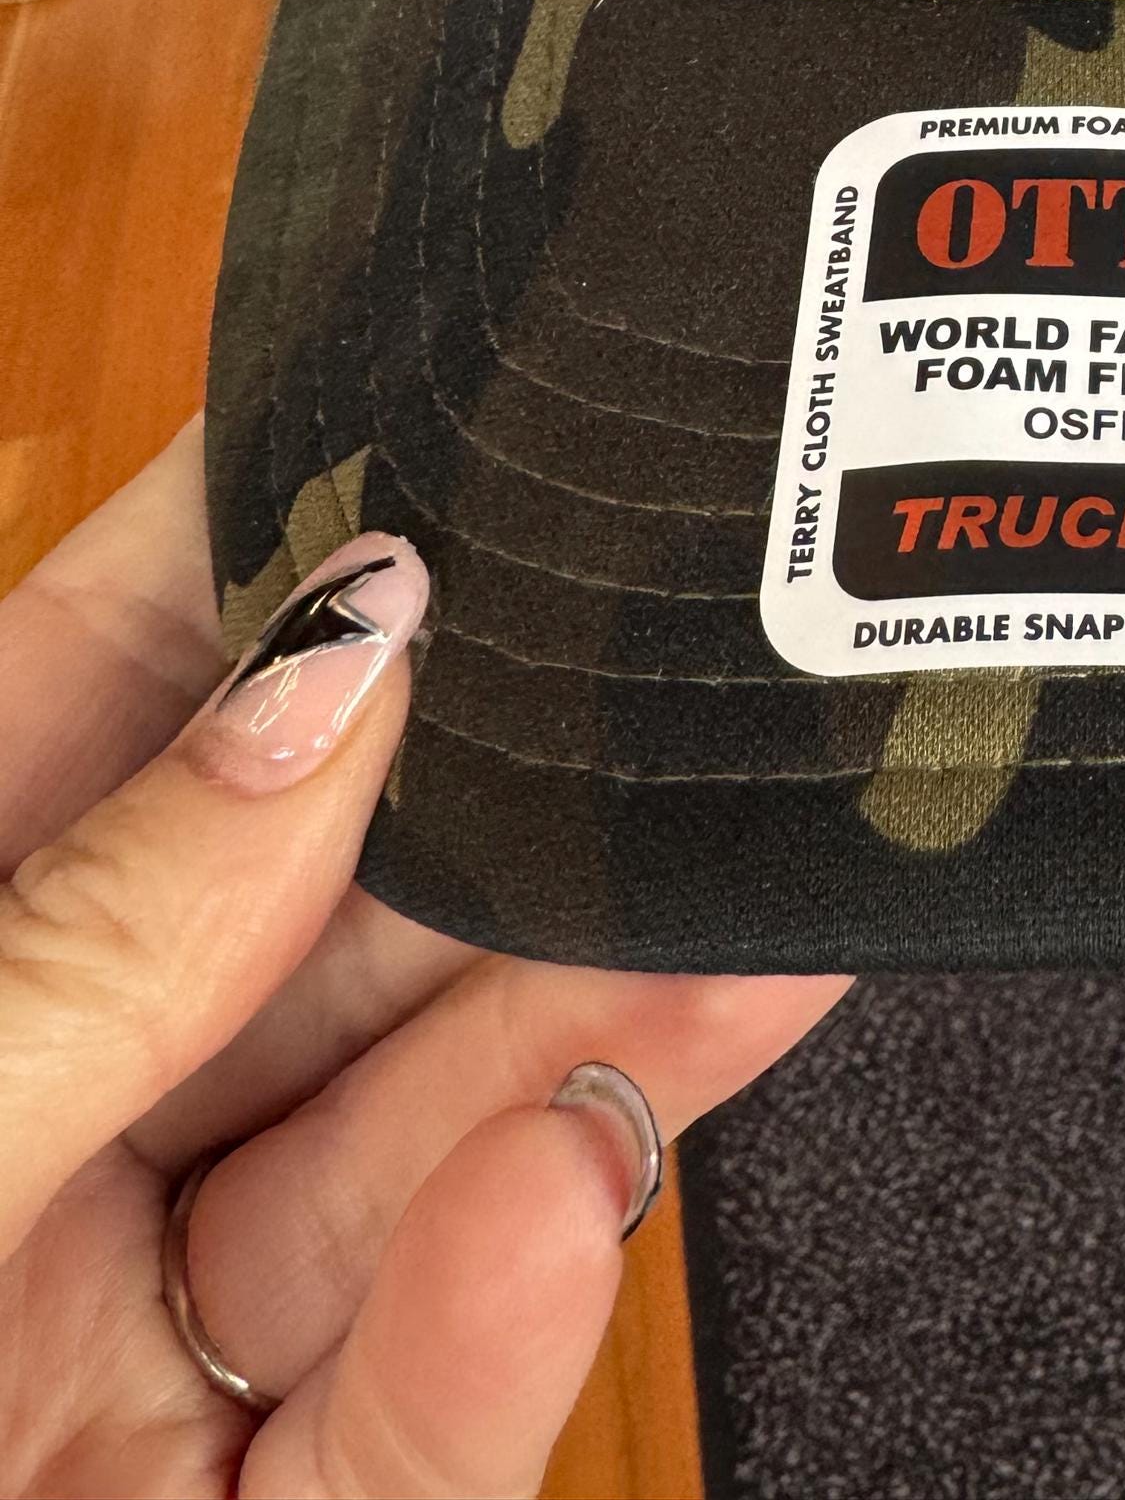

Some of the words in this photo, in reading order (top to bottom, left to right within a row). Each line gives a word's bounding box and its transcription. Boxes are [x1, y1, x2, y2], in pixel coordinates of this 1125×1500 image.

[920, 116, 1060, 140] PREMIUM
[815, 185, 859, 362] SWEATBAND
[879, 316, 1070, 354] WORLD
[914, 356, 1067, 393] FOAM
[801, 372, 836, 472] CLOTH
[786, 483, 822, 584] TERRY
[853, 615, 1010, 649] DURABLE
[1023, 613, 1125, 641] SNAP
